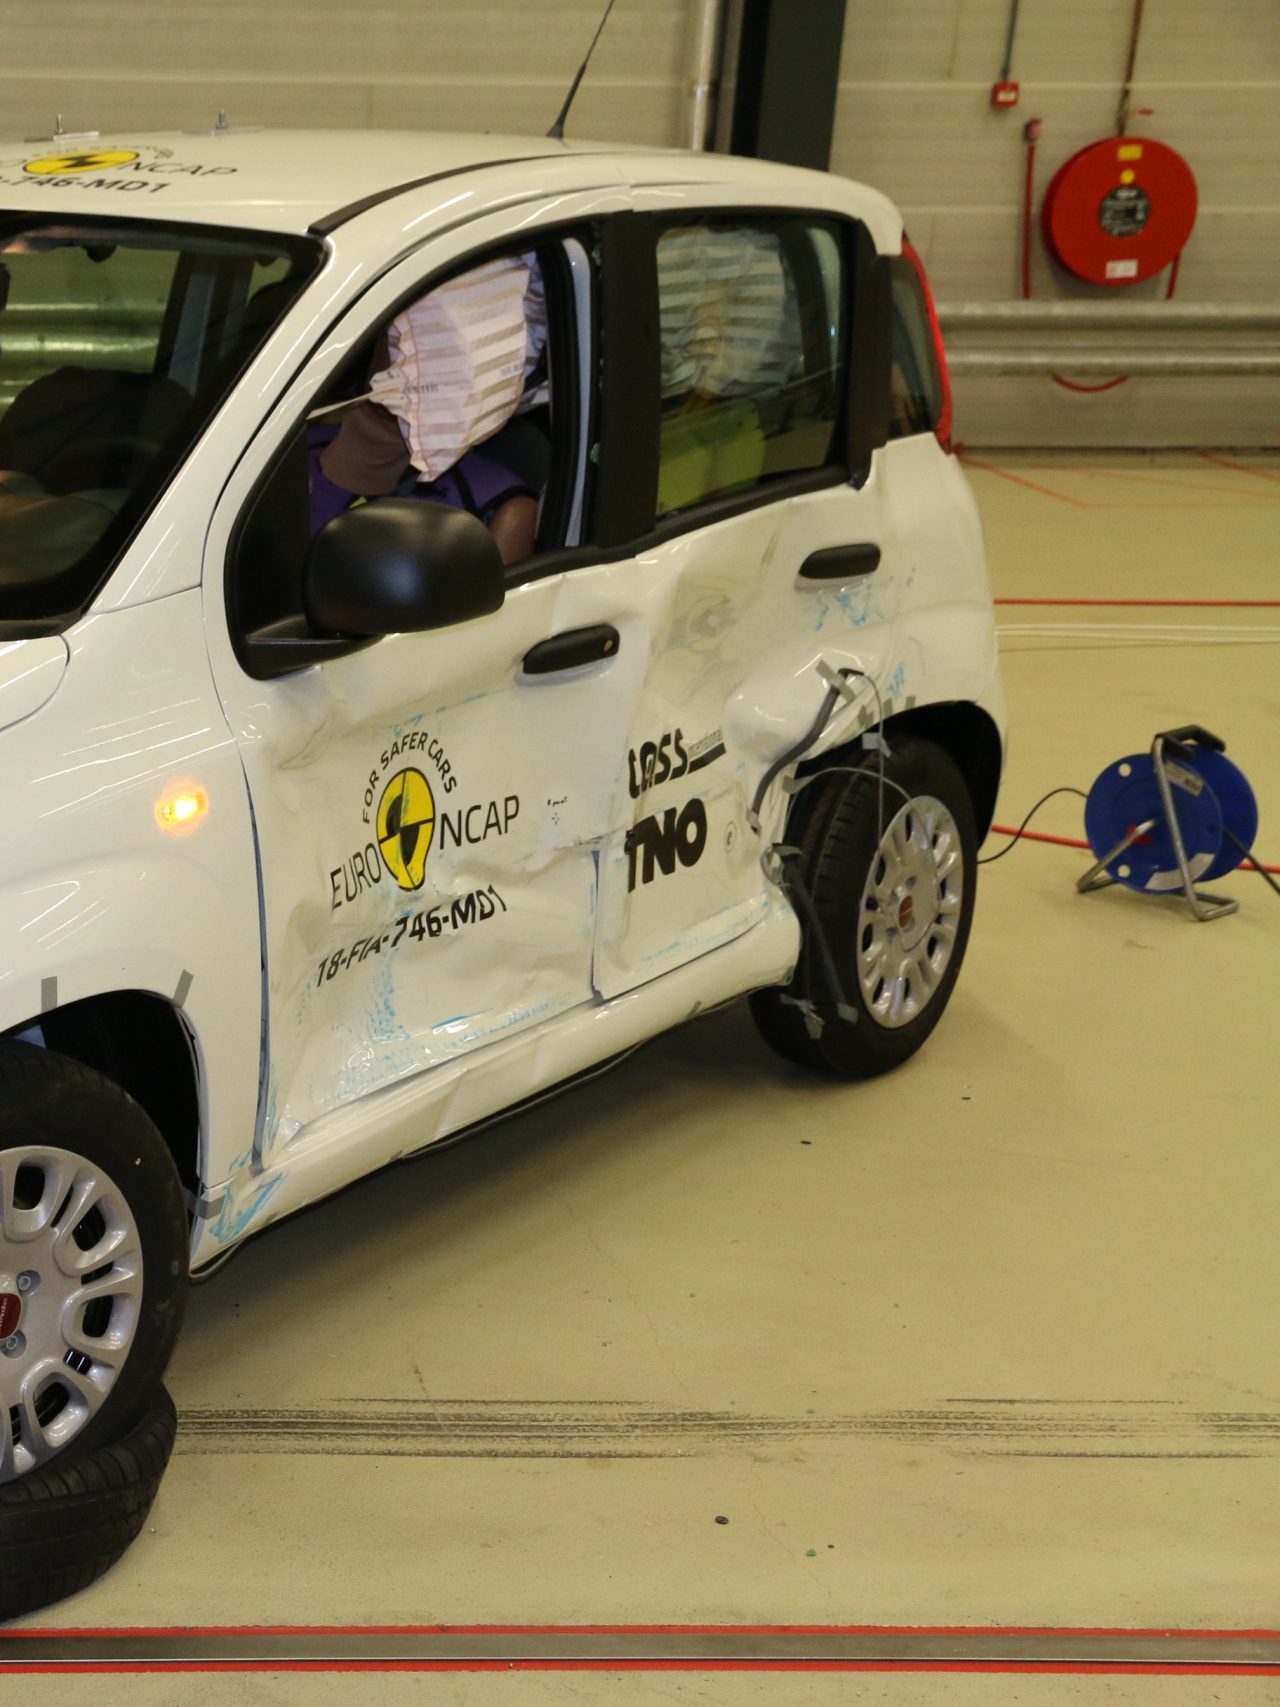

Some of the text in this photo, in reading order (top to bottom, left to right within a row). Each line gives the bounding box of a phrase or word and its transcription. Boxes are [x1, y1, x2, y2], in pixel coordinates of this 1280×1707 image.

[117, 161, 238, 177] NCAP
[362, 731, 458, 825] FOR SAFER CARS
[330, 795, 520, 912] EURO NCAP
[624, 798, 708, 894] TNO
[316, 883, 508, 988] 18-FIA-746-MD1
